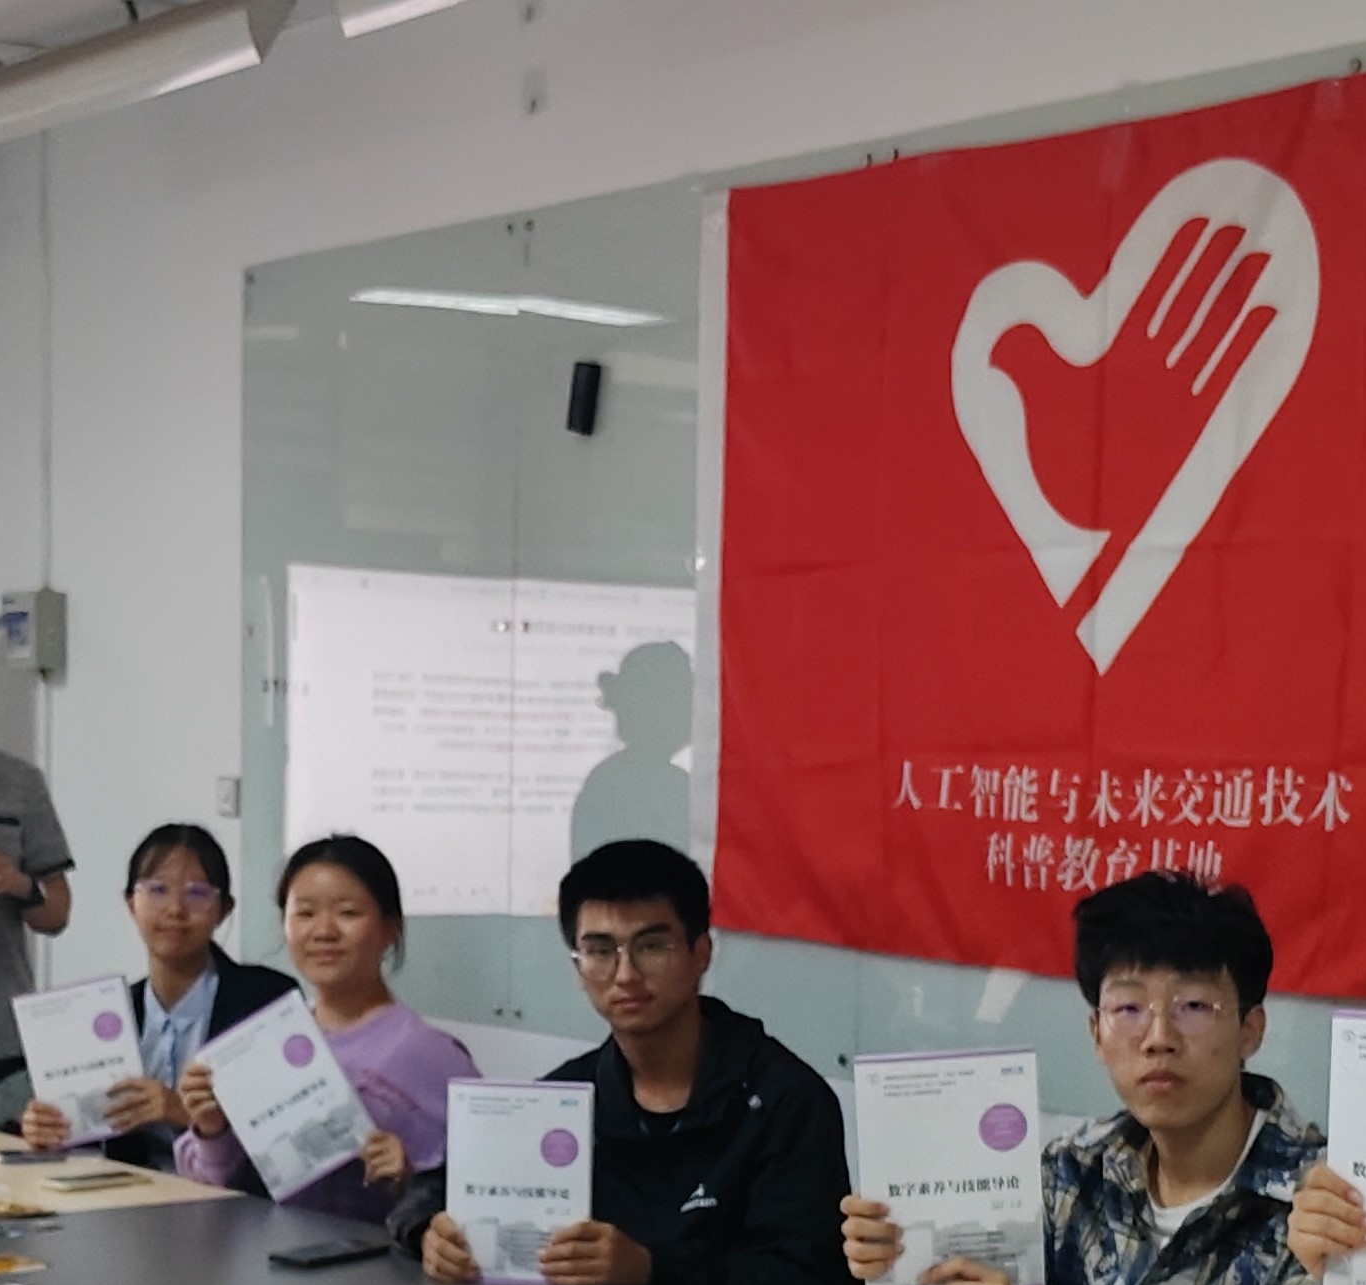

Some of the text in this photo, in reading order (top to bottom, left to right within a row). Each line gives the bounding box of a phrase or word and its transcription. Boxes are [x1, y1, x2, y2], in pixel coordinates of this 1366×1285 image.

[893, 760, 1353, 832] 人工智能与未来交通技术
[888, 1175, 1020, 1197] 数字素养与技能导论
